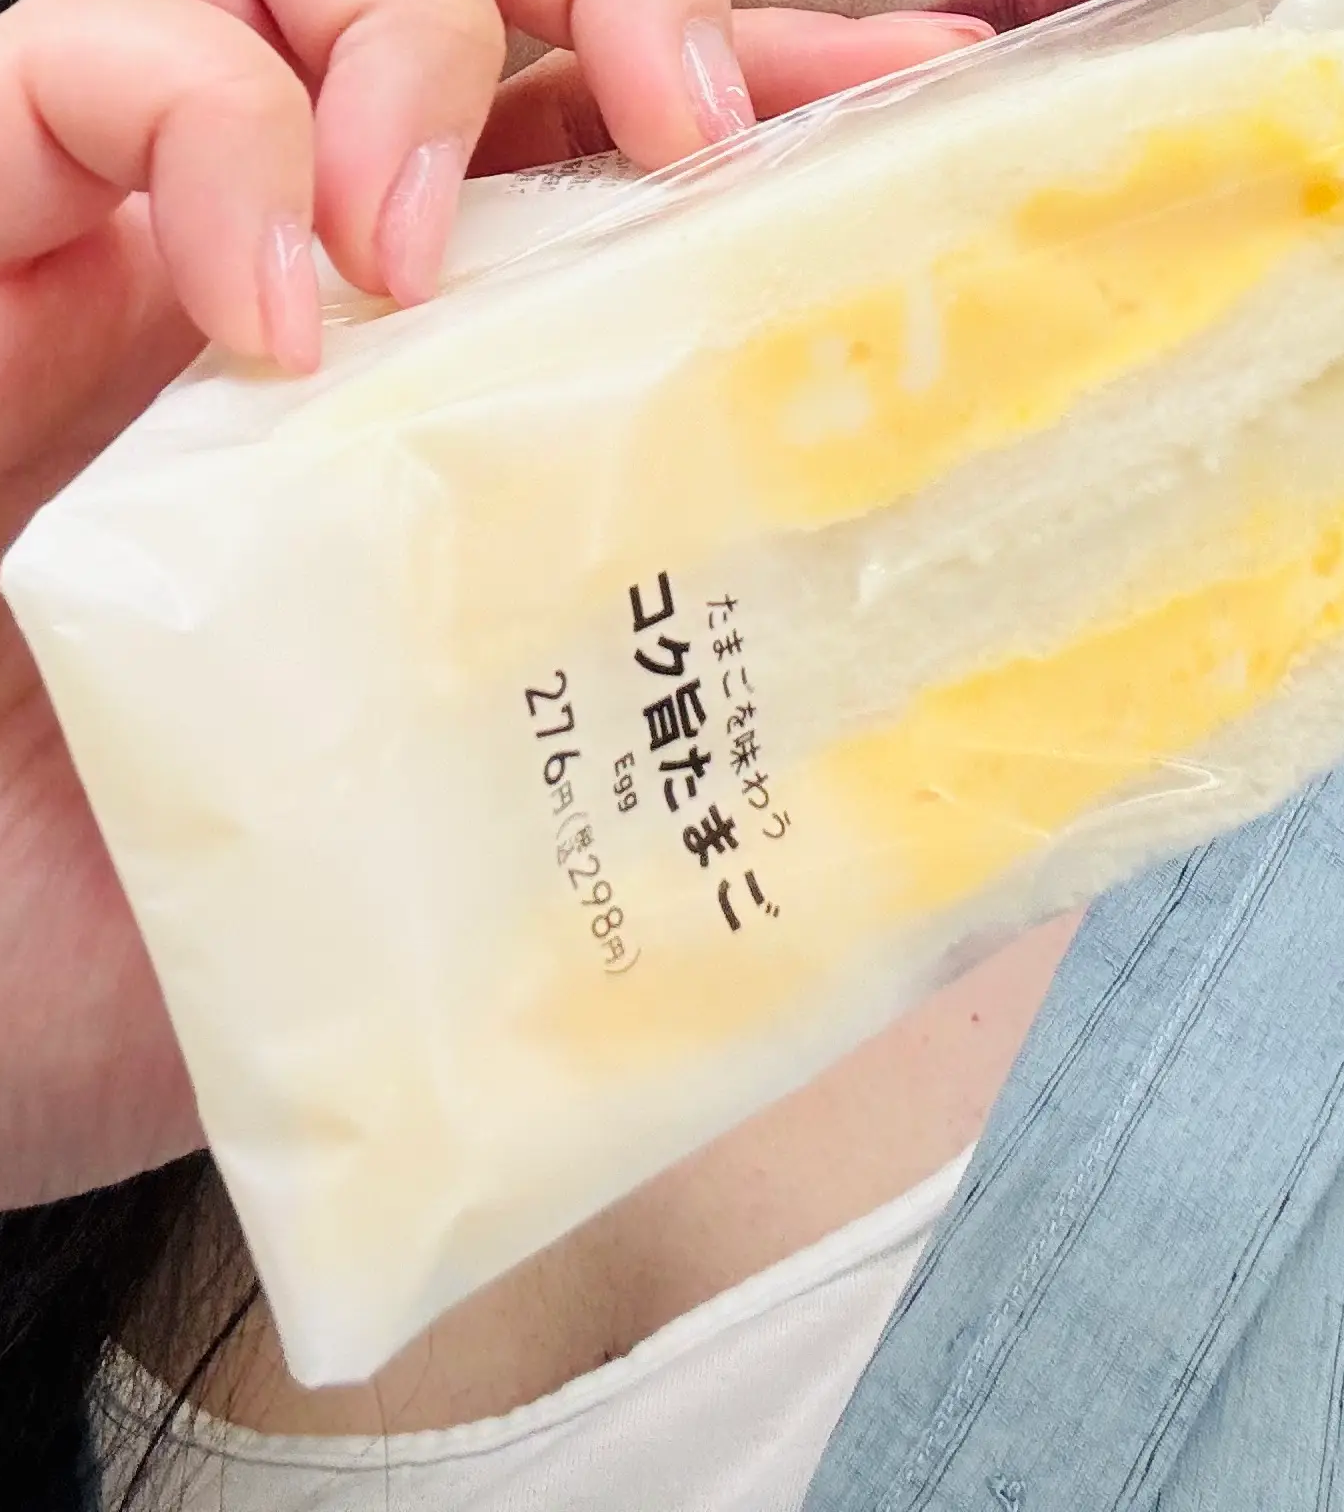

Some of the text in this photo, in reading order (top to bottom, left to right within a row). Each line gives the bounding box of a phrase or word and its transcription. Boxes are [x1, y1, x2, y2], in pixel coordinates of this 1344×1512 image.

[614, 751, 638, 814] Egg
[629, 570, 780, 932] コク旨たまご
[706, 593, 792, 839] たまごを味わう
